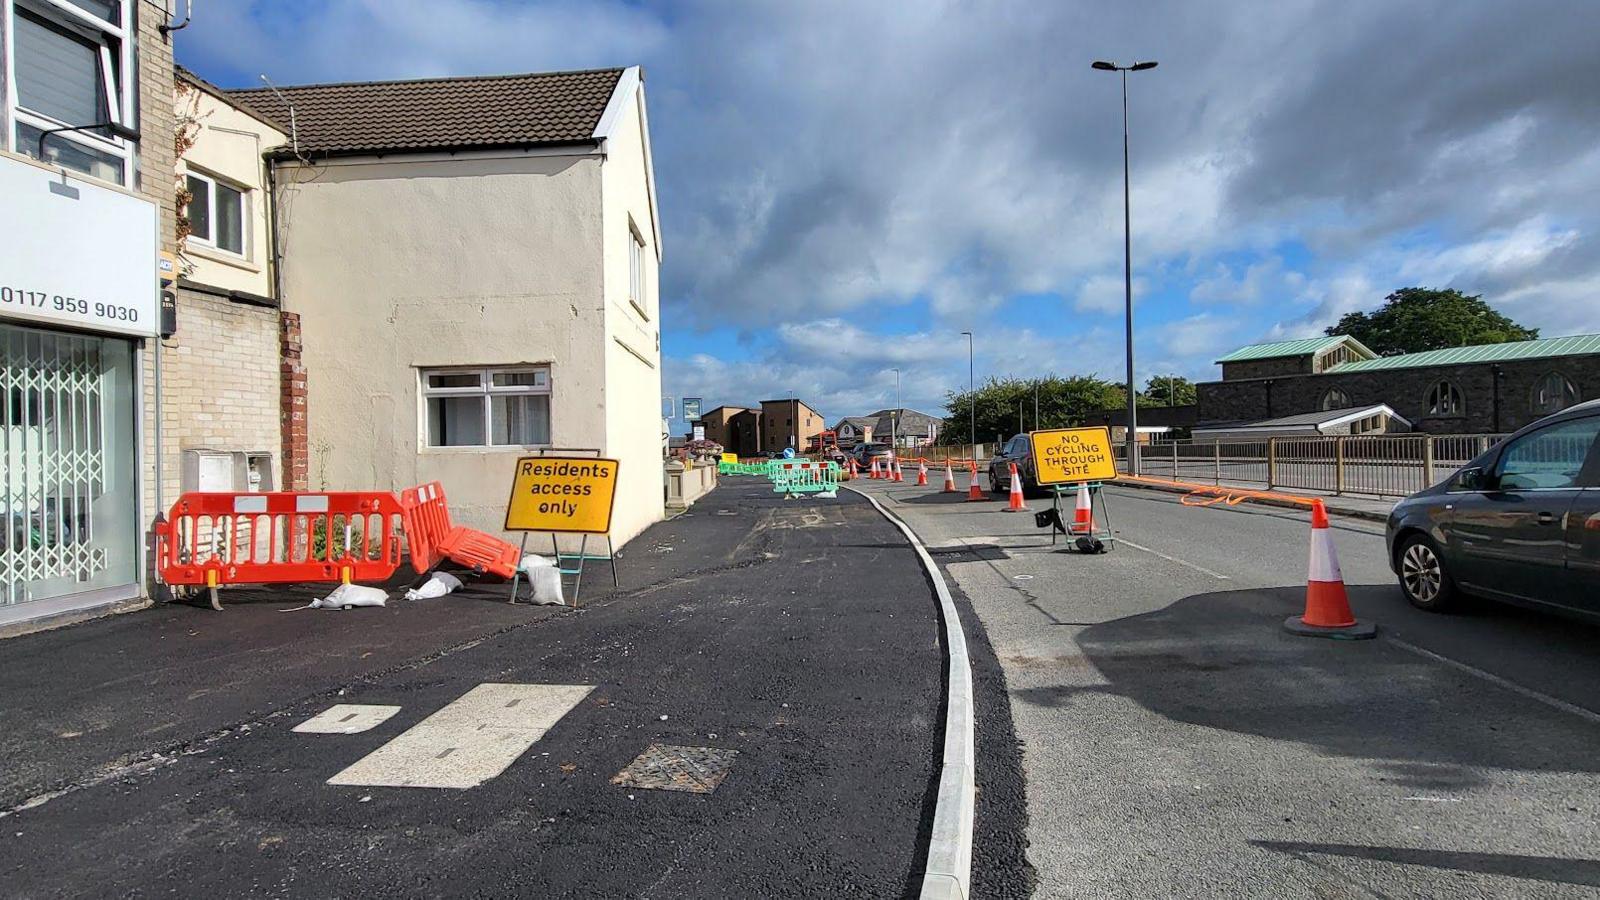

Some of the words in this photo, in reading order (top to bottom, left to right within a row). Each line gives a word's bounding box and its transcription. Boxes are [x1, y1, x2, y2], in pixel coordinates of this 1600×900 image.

[1, 286, 47, 307] 0117
[53, 295, 88, 315] 959
[95, 302, 138, 322] 9030
[1061, 435, 1080, 444] NO
[1046, 444, 1099, 455] CYCLING
[1044, 454, 1105, 466] THROUGH
[522, 462, 609, 478] Residents
[1063, 465, 1090, 475] SITE
[532, 484, 592, 495] access
[539, 499, 577, 517] only
